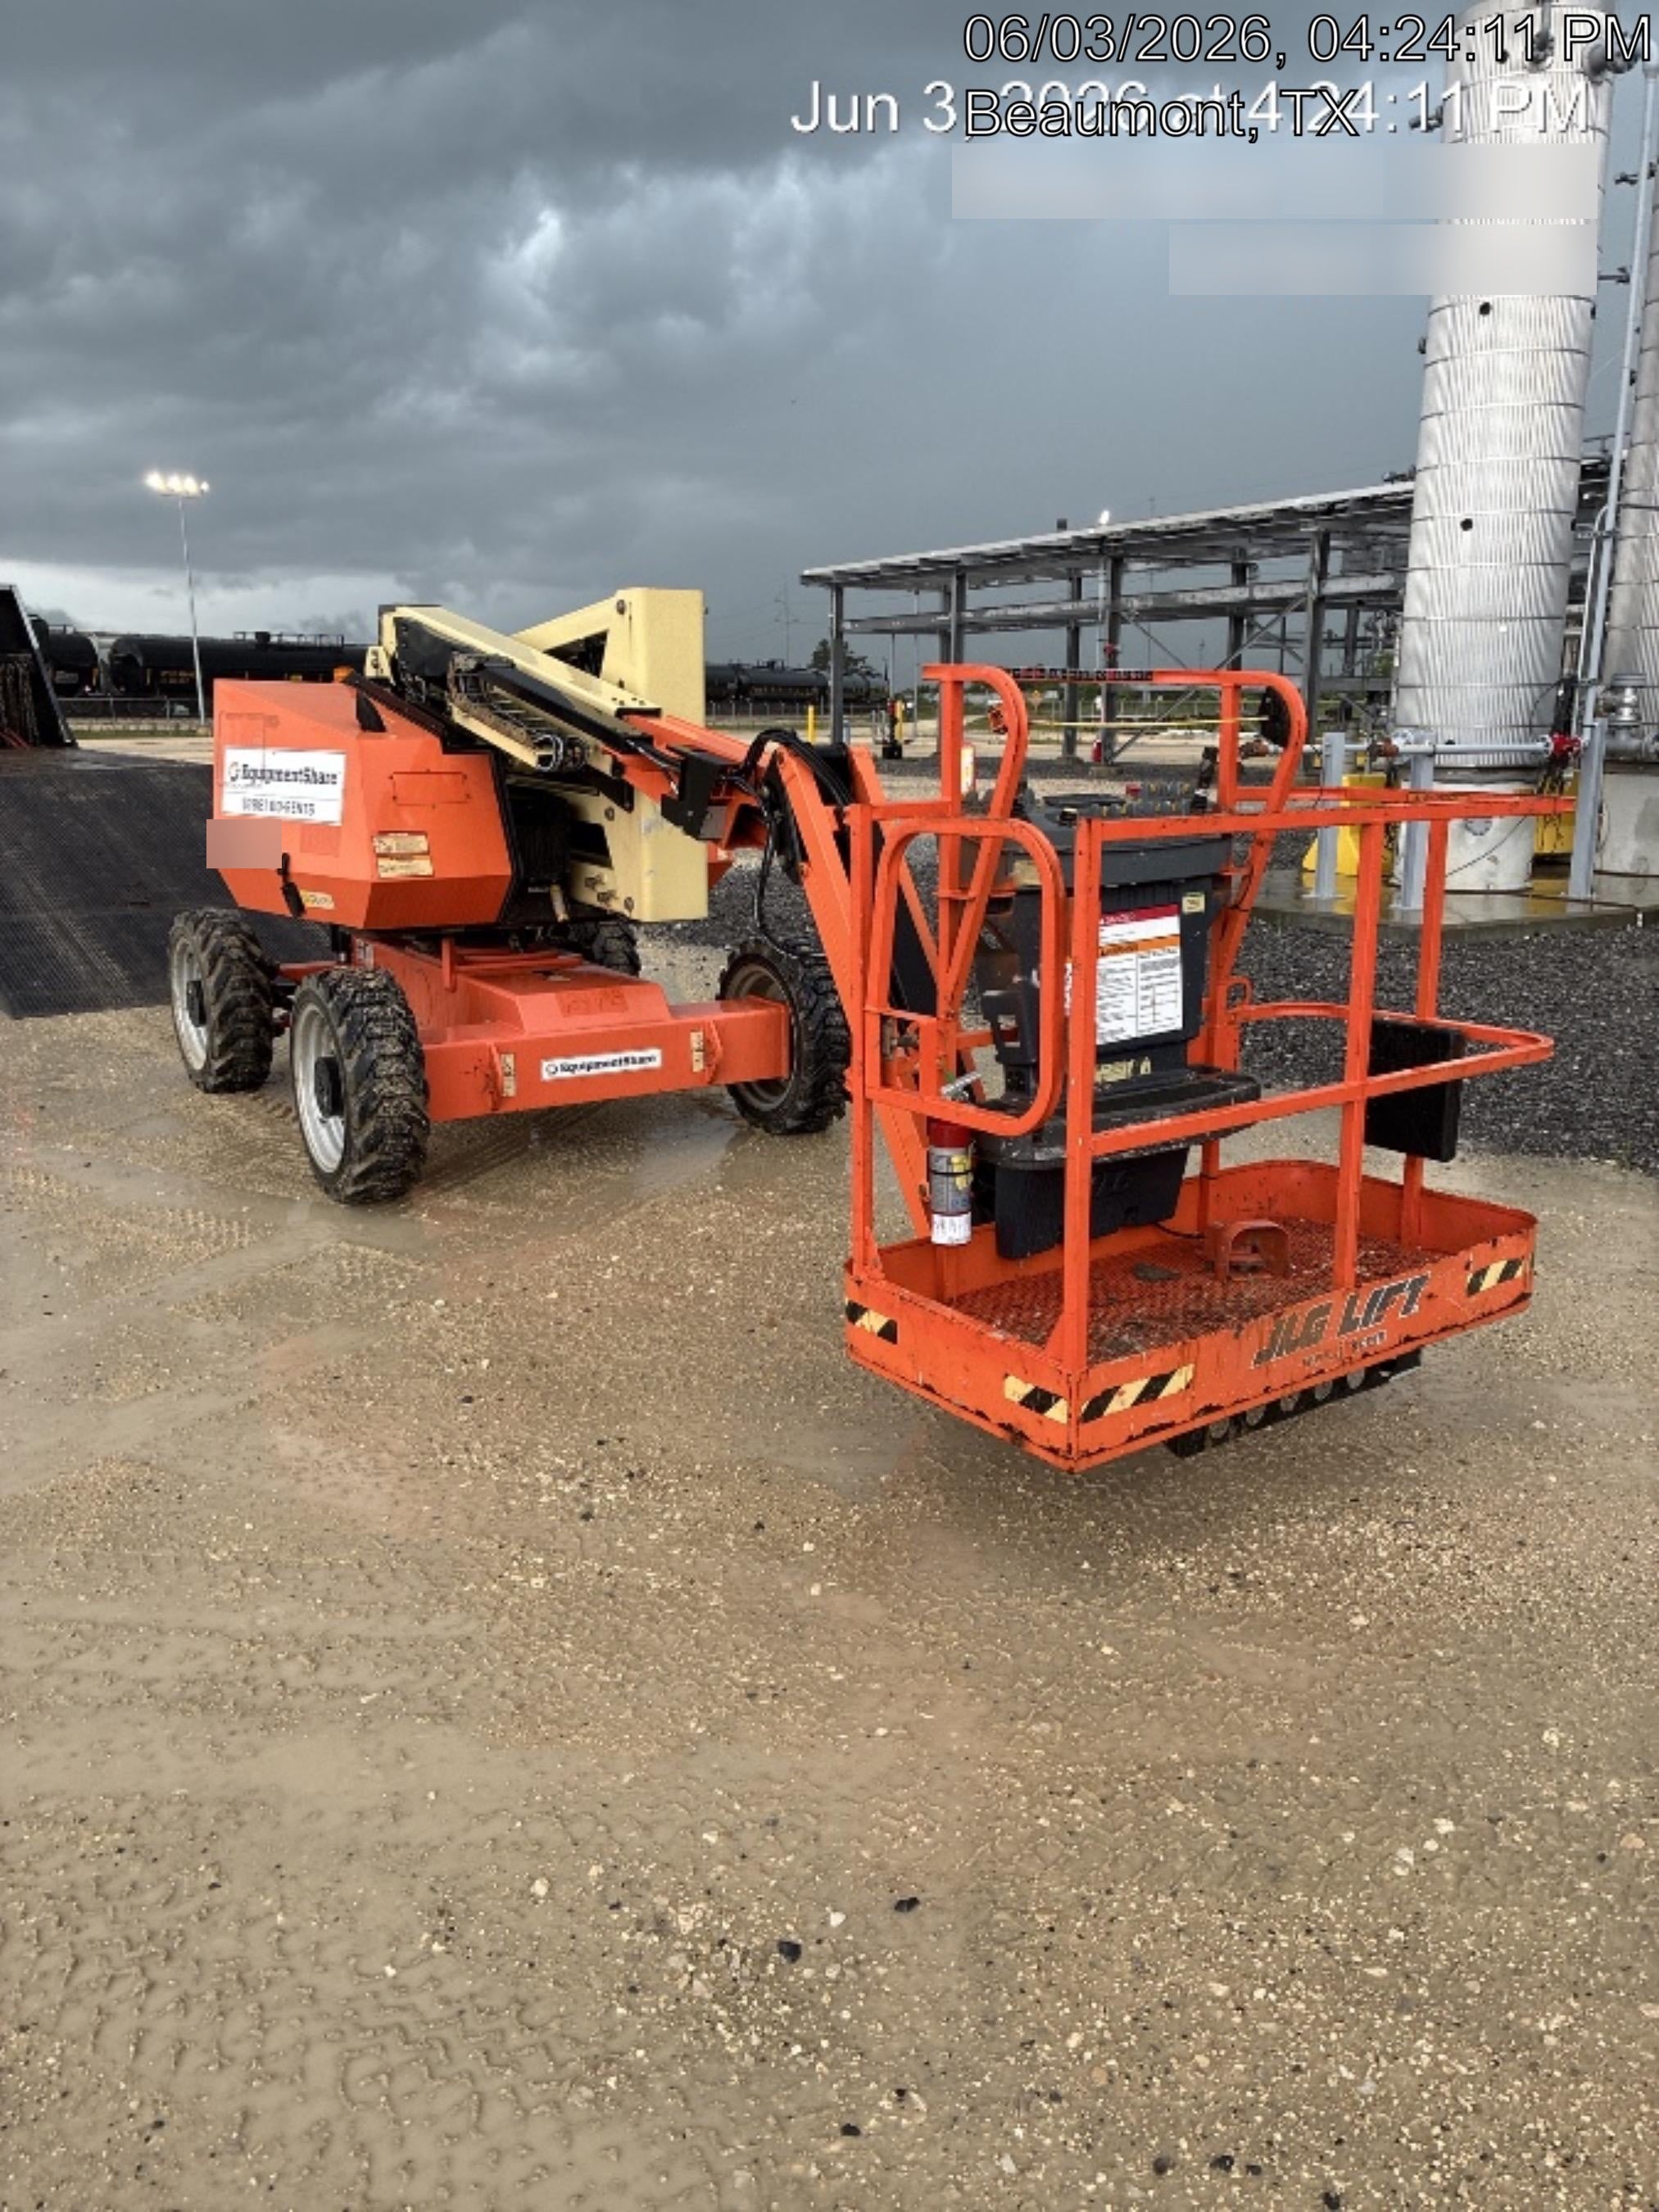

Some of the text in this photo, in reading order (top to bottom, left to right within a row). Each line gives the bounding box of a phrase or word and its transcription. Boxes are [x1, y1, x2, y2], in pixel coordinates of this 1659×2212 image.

[242, 763, 338, 785] EquipmentShare
[1251, 1271, 1431, 1368] JLG LIFT
